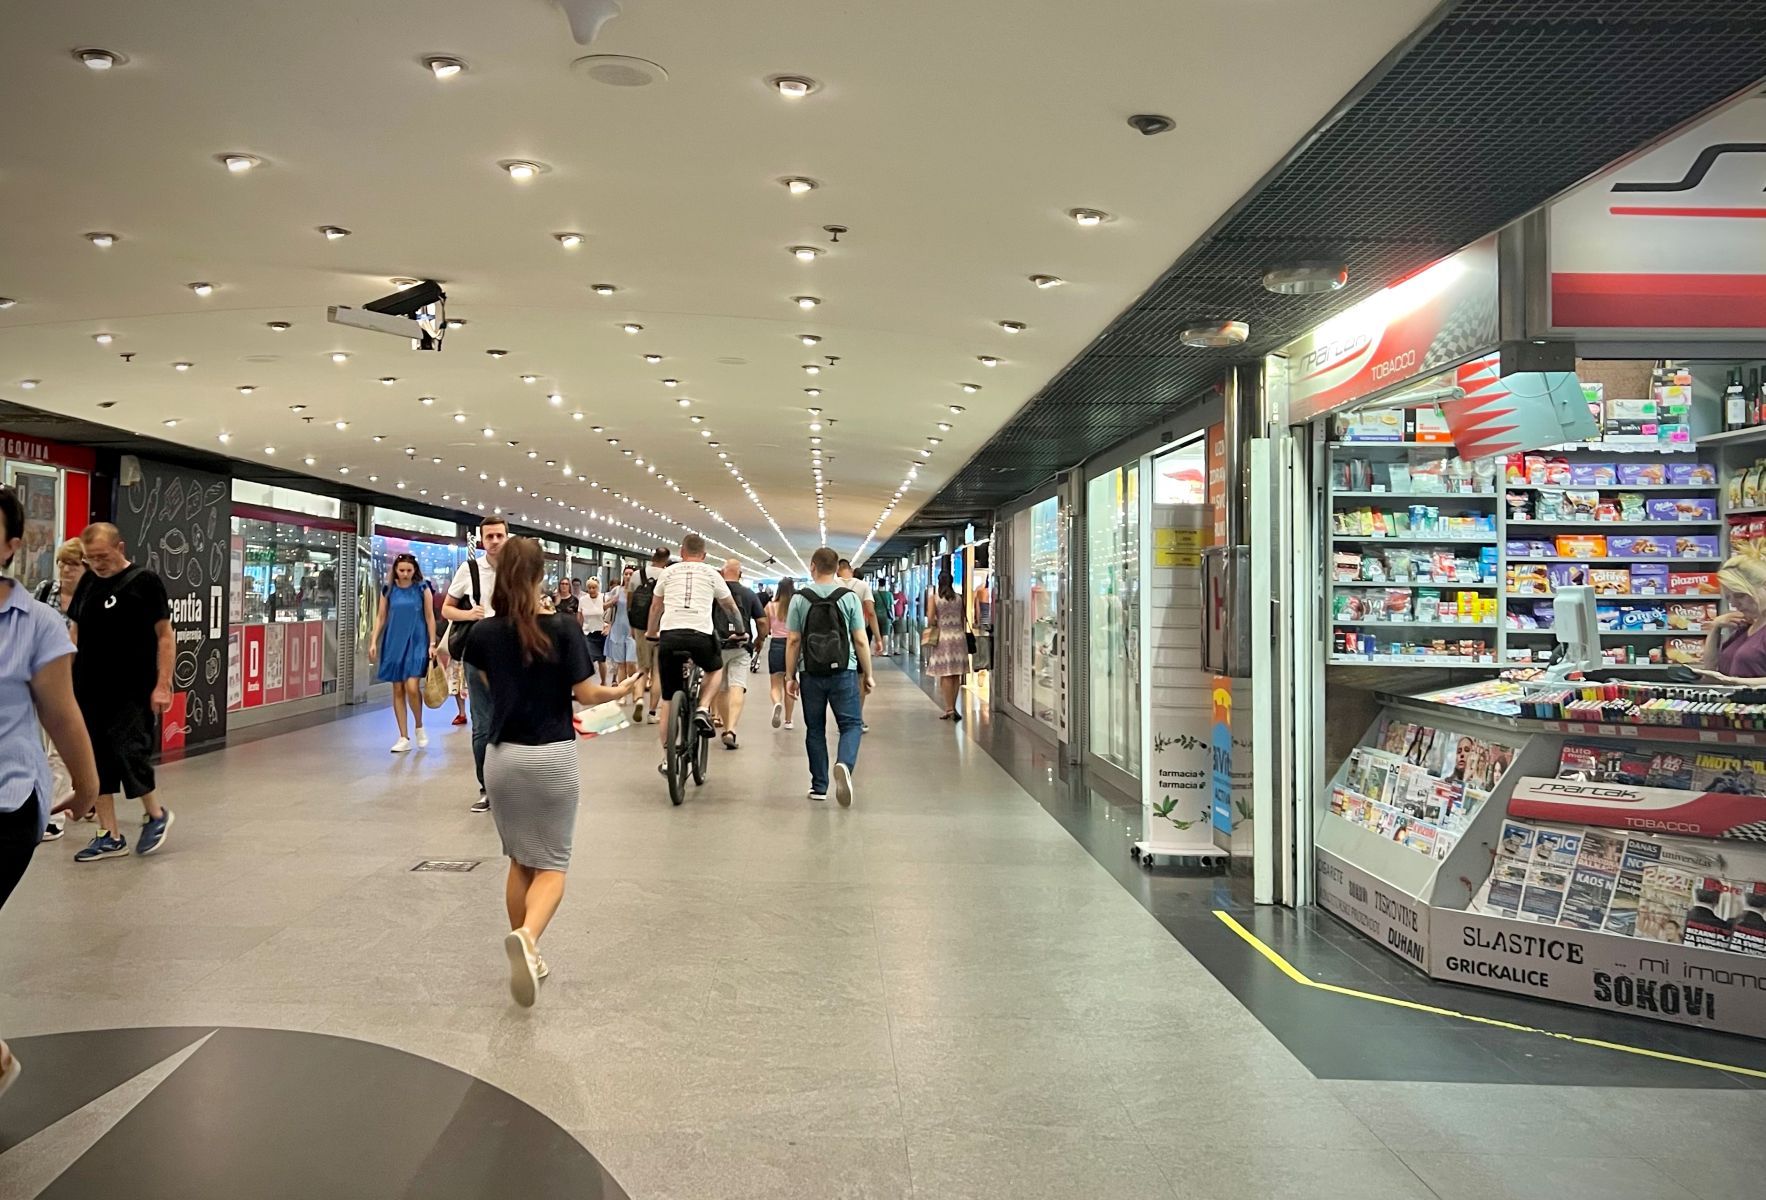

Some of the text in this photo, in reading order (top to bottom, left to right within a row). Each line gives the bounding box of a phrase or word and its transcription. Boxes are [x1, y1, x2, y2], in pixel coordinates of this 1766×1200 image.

[1371, 349, 1416, 380] TOBACCO
[1670, 576, 1710, 587] plazma
[1563, 746, 1592, 755] auto
[1159, 769, 1198, 778] farmacia
[1159, 781, 1198, 789] farmacia
[1625, 817, 1700, 833] TOBACCO
[1628, 840, 1658, 854] DANAS
[1576, 873, 1605, 887] KAOS
[1375, 890, 1418, 933] TISKOVINE
[1388, 927, 1424, 964] DUHANI
[1463, 926, 1584, 965] SLASTICE
[1446, 956, 1549, 988] GRICKALICE
[1639, 957, 1670, 975] mi
[1593, 972, 1716, 1020] SOKOVI
